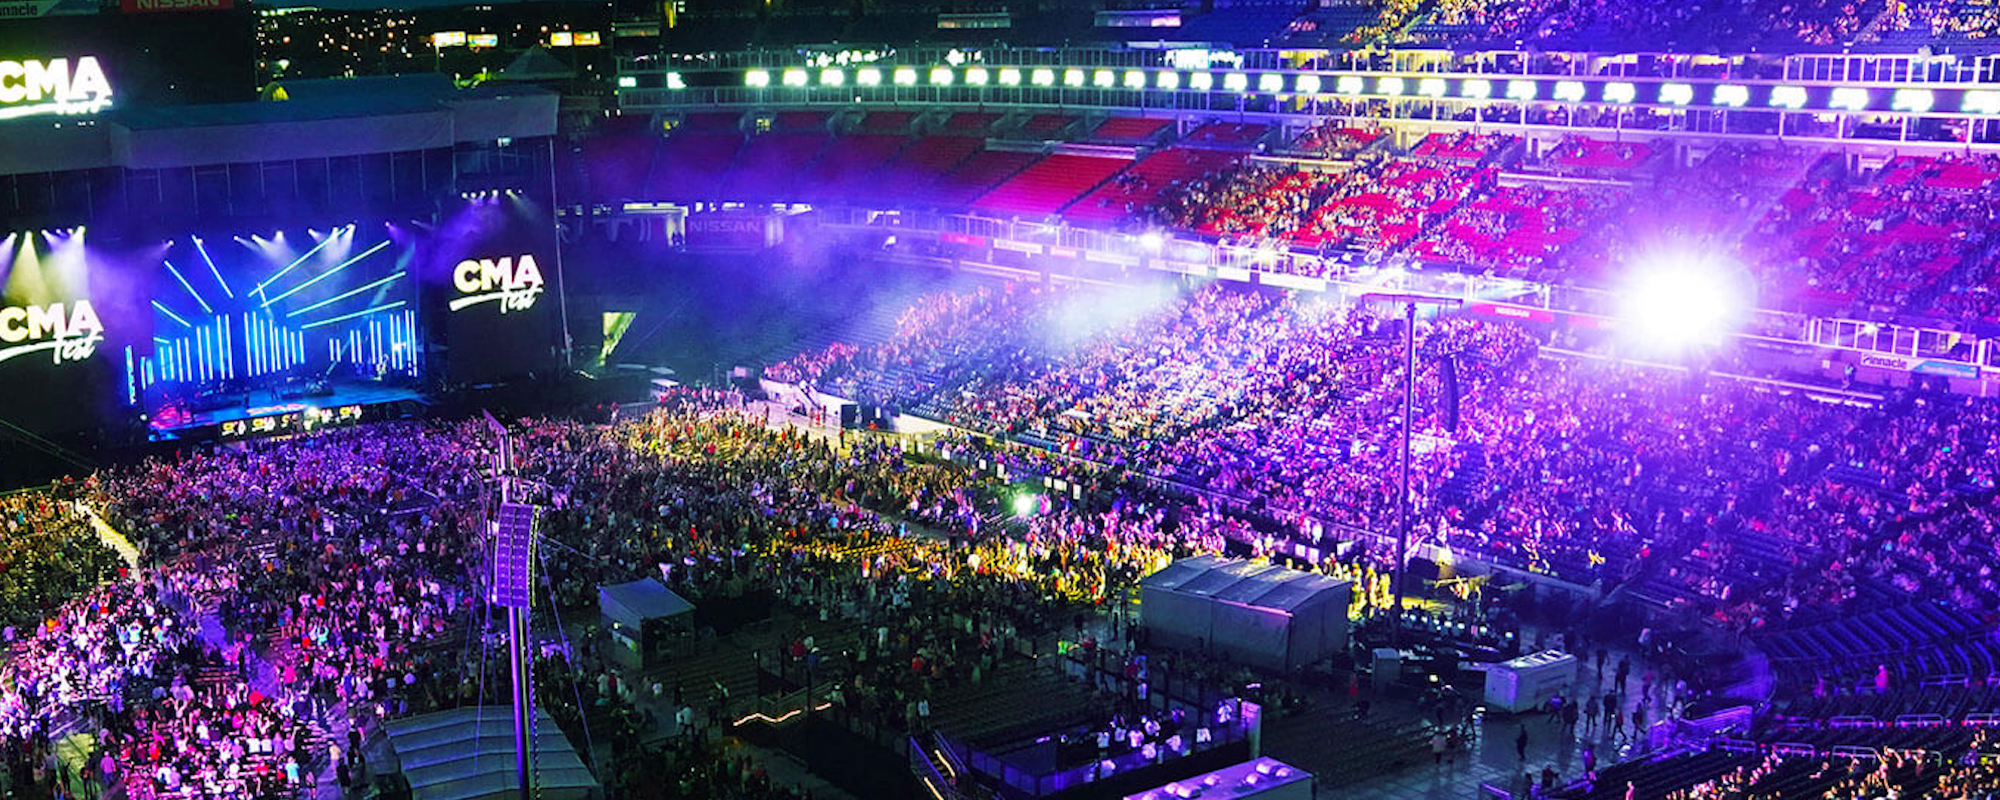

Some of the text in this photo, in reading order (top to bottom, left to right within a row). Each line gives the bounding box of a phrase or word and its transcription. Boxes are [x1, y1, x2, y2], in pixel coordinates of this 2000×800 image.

[0, 56, 113, 102] CMA
[690, 220, 761, 232] NISSAN
[453, 254, 544, 293] CMA
[0, 299, 104, 342] CMA
